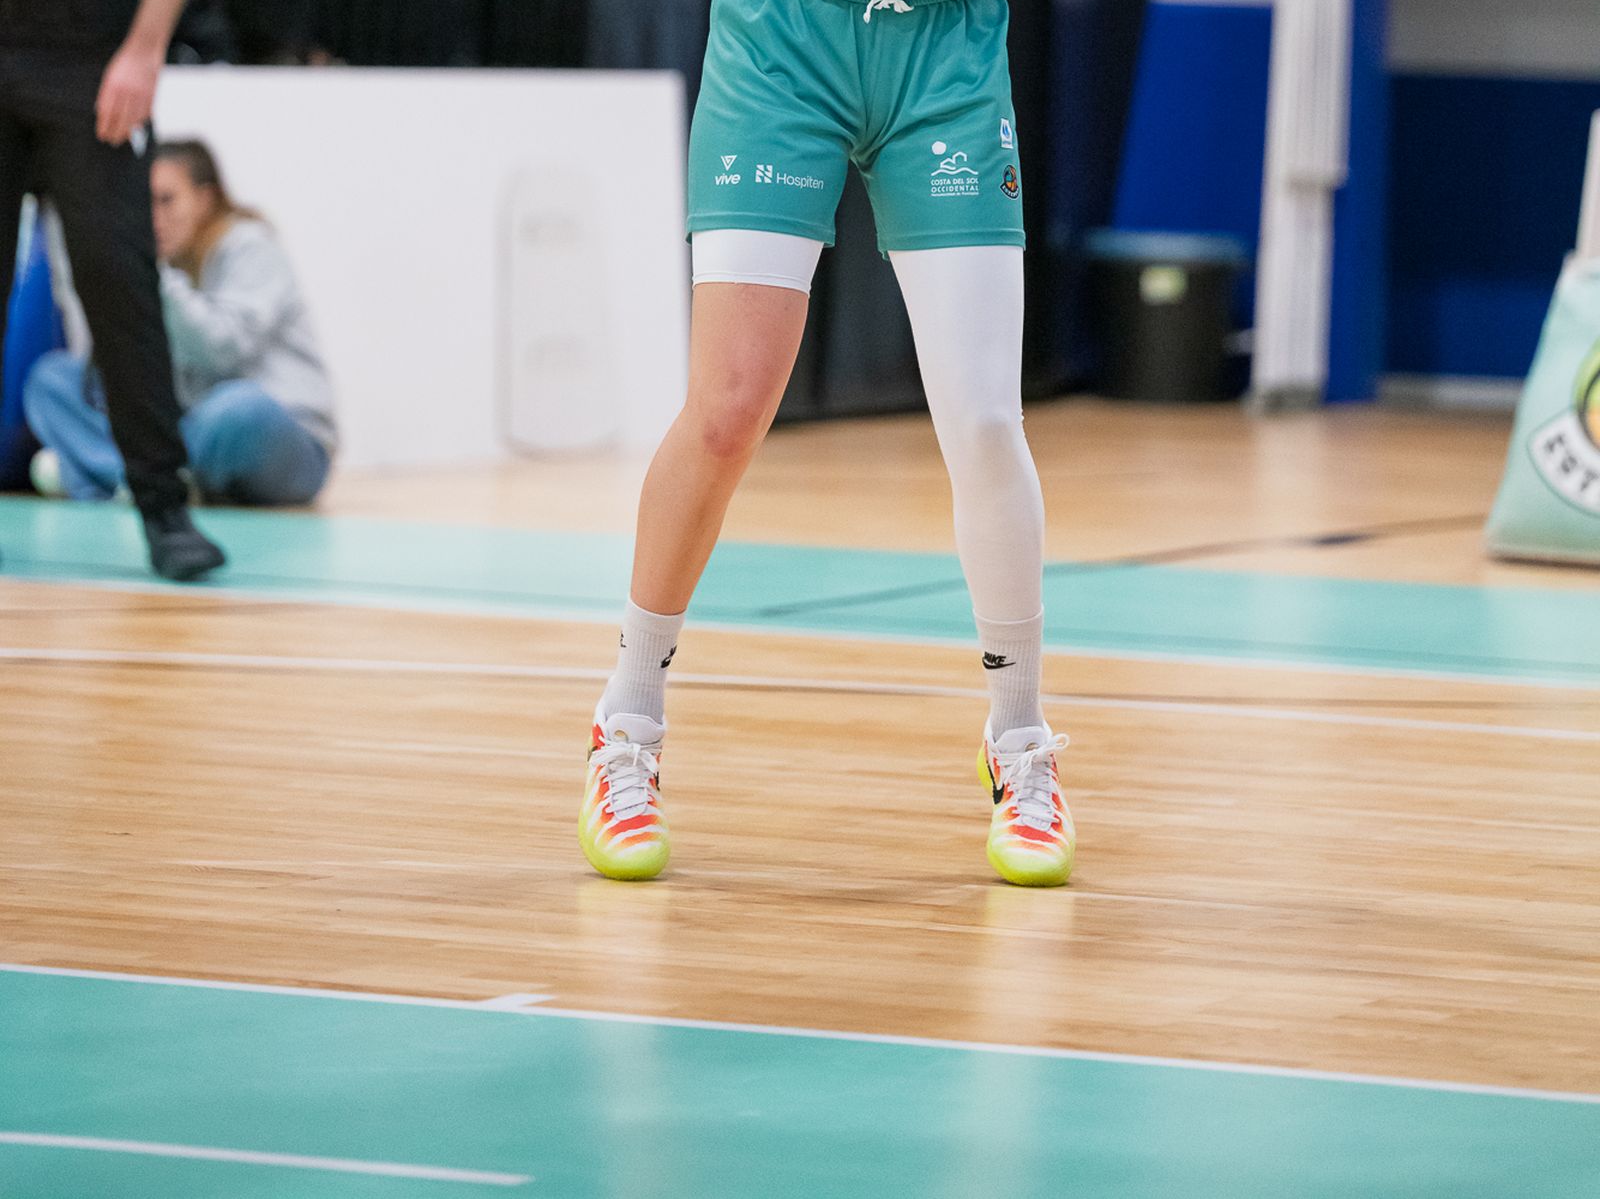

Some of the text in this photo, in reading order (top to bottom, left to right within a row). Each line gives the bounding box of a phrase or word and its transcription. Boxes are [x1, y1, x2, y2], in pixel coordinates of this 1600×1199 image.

[714, 172, 824, 190] vive Hospiten
[966, 177, 979, 185] SOL
[930, 185, 979, 193] OCCIDENTAL
